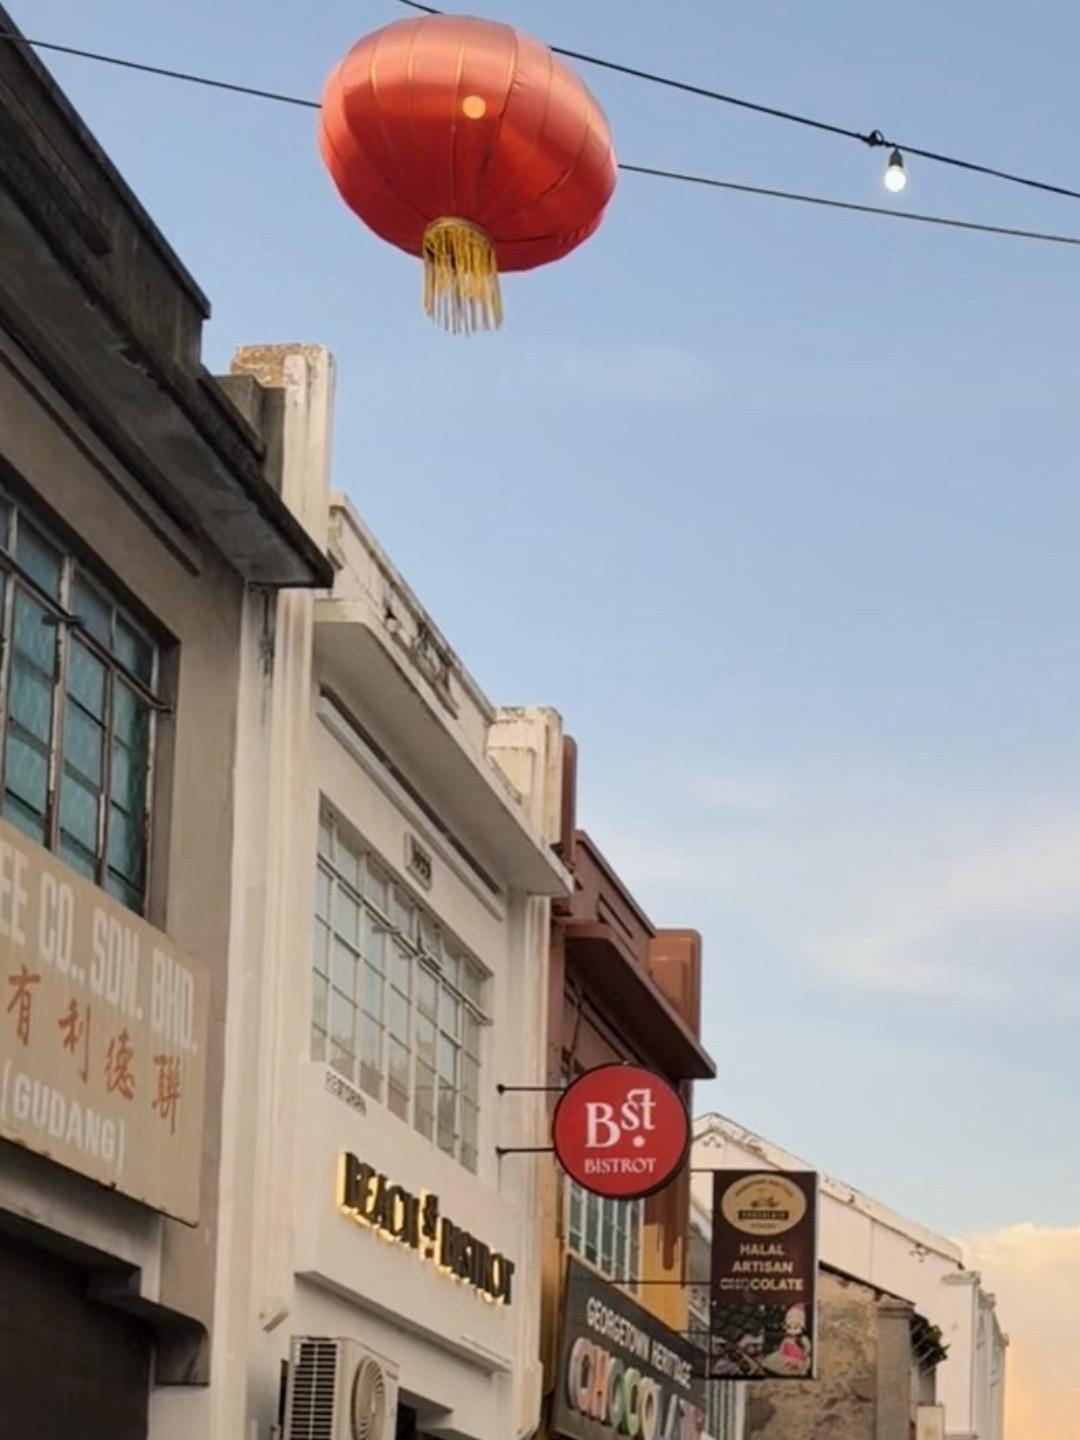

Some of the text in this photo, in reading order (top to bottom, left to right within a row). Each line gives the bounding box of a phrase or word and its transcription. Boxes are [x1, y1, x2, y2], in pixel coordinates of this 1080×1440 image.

[91, 906, 143, 1020] SDN.
[152, 947, 197, 1053] BHD.
[2, 1059, 126, 1174] (GUDANG)
[583, 1157, 657, 1175] BISTROT
[739, 1244, 785, 1256] HALAL
[732, 1261, 793, 1274] ARTISAN
[720, 1278, 804, 1291] CHOCOLATE
